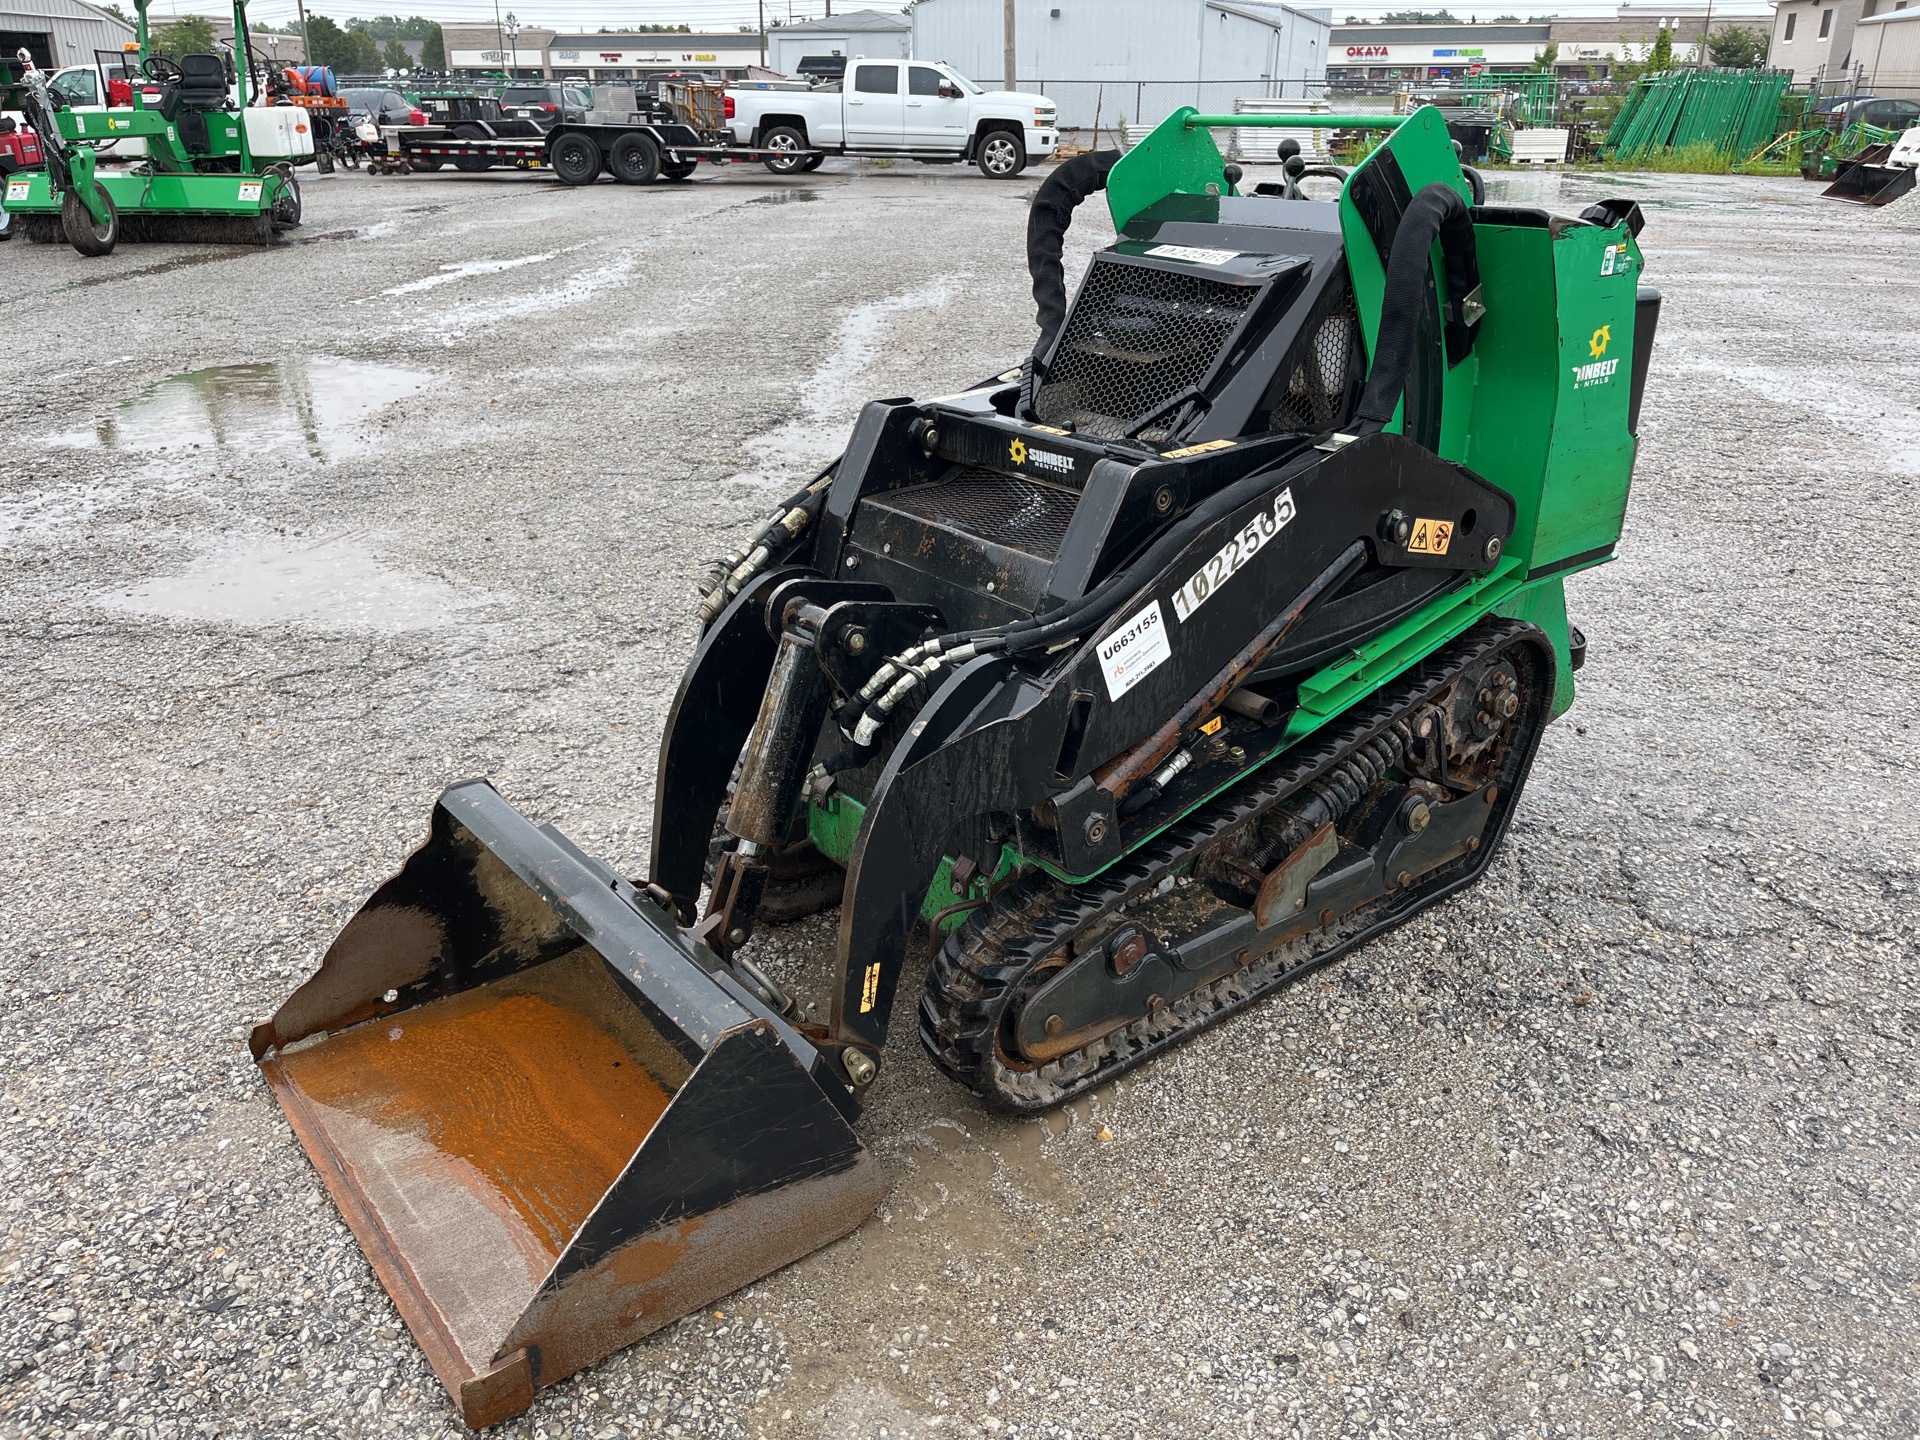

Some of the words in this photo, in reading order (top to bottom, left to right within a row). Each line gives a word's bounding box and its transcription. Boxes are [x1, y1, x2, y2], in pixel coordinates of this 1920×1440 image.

[695, 54, 716, 62] NAILS
[1346, 46, 1389, 57] OKAYA
[1028, 447, 1074, 470] SUNBELT
[1034, 461, 1068, 474] RENTALS
[1175, 492, 1293, 614] 1022565
[1103, 611, 1158, 660] U663155
